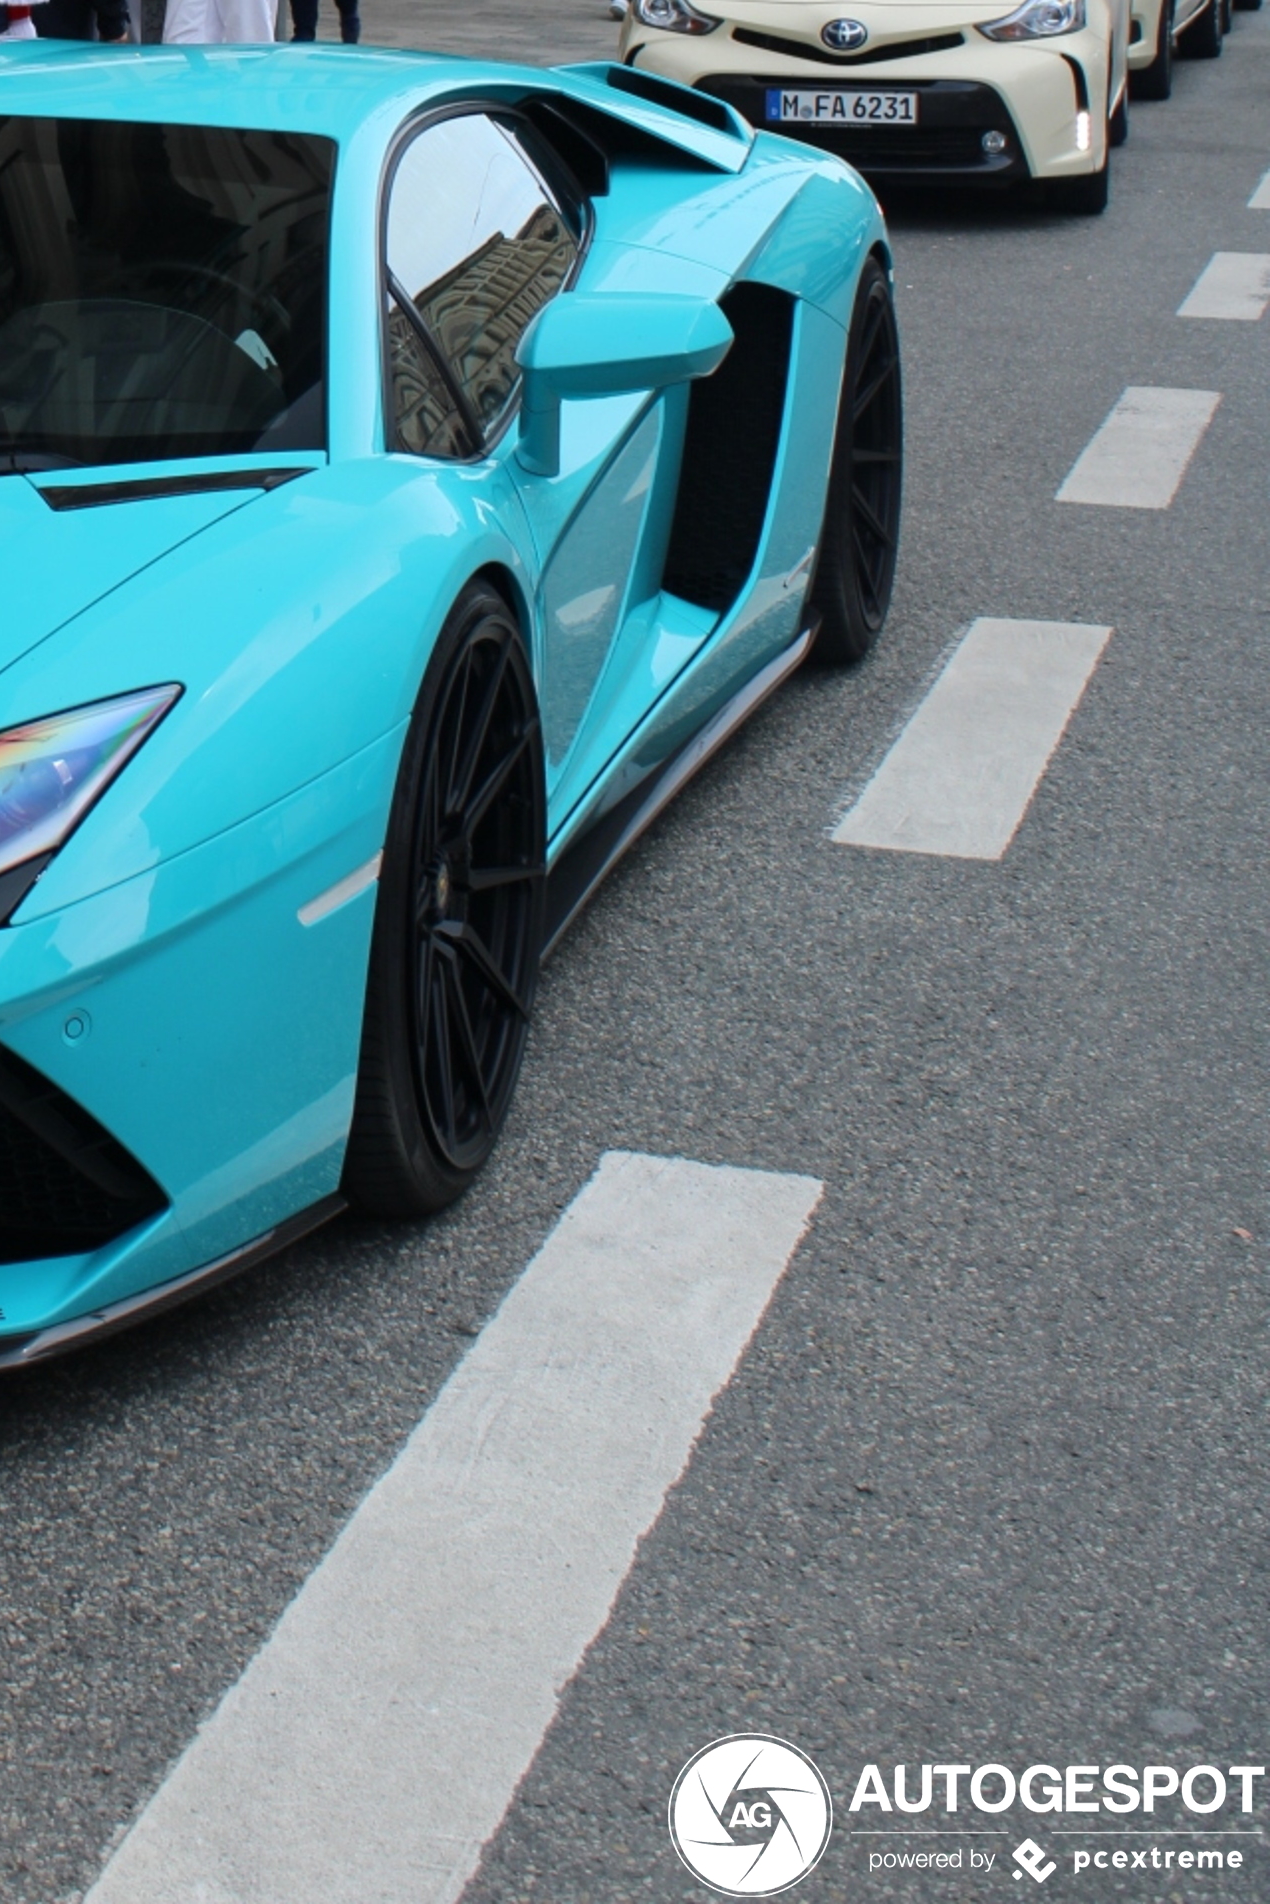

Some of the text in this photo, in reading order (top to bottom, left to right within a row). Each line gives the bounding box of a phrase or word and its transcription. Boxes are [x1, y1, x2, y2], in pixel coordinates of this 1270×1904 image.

[782, 94, 799, 118] M
[815, 95, 846, 118] FA
[852, 96, 914, 120] 6231
